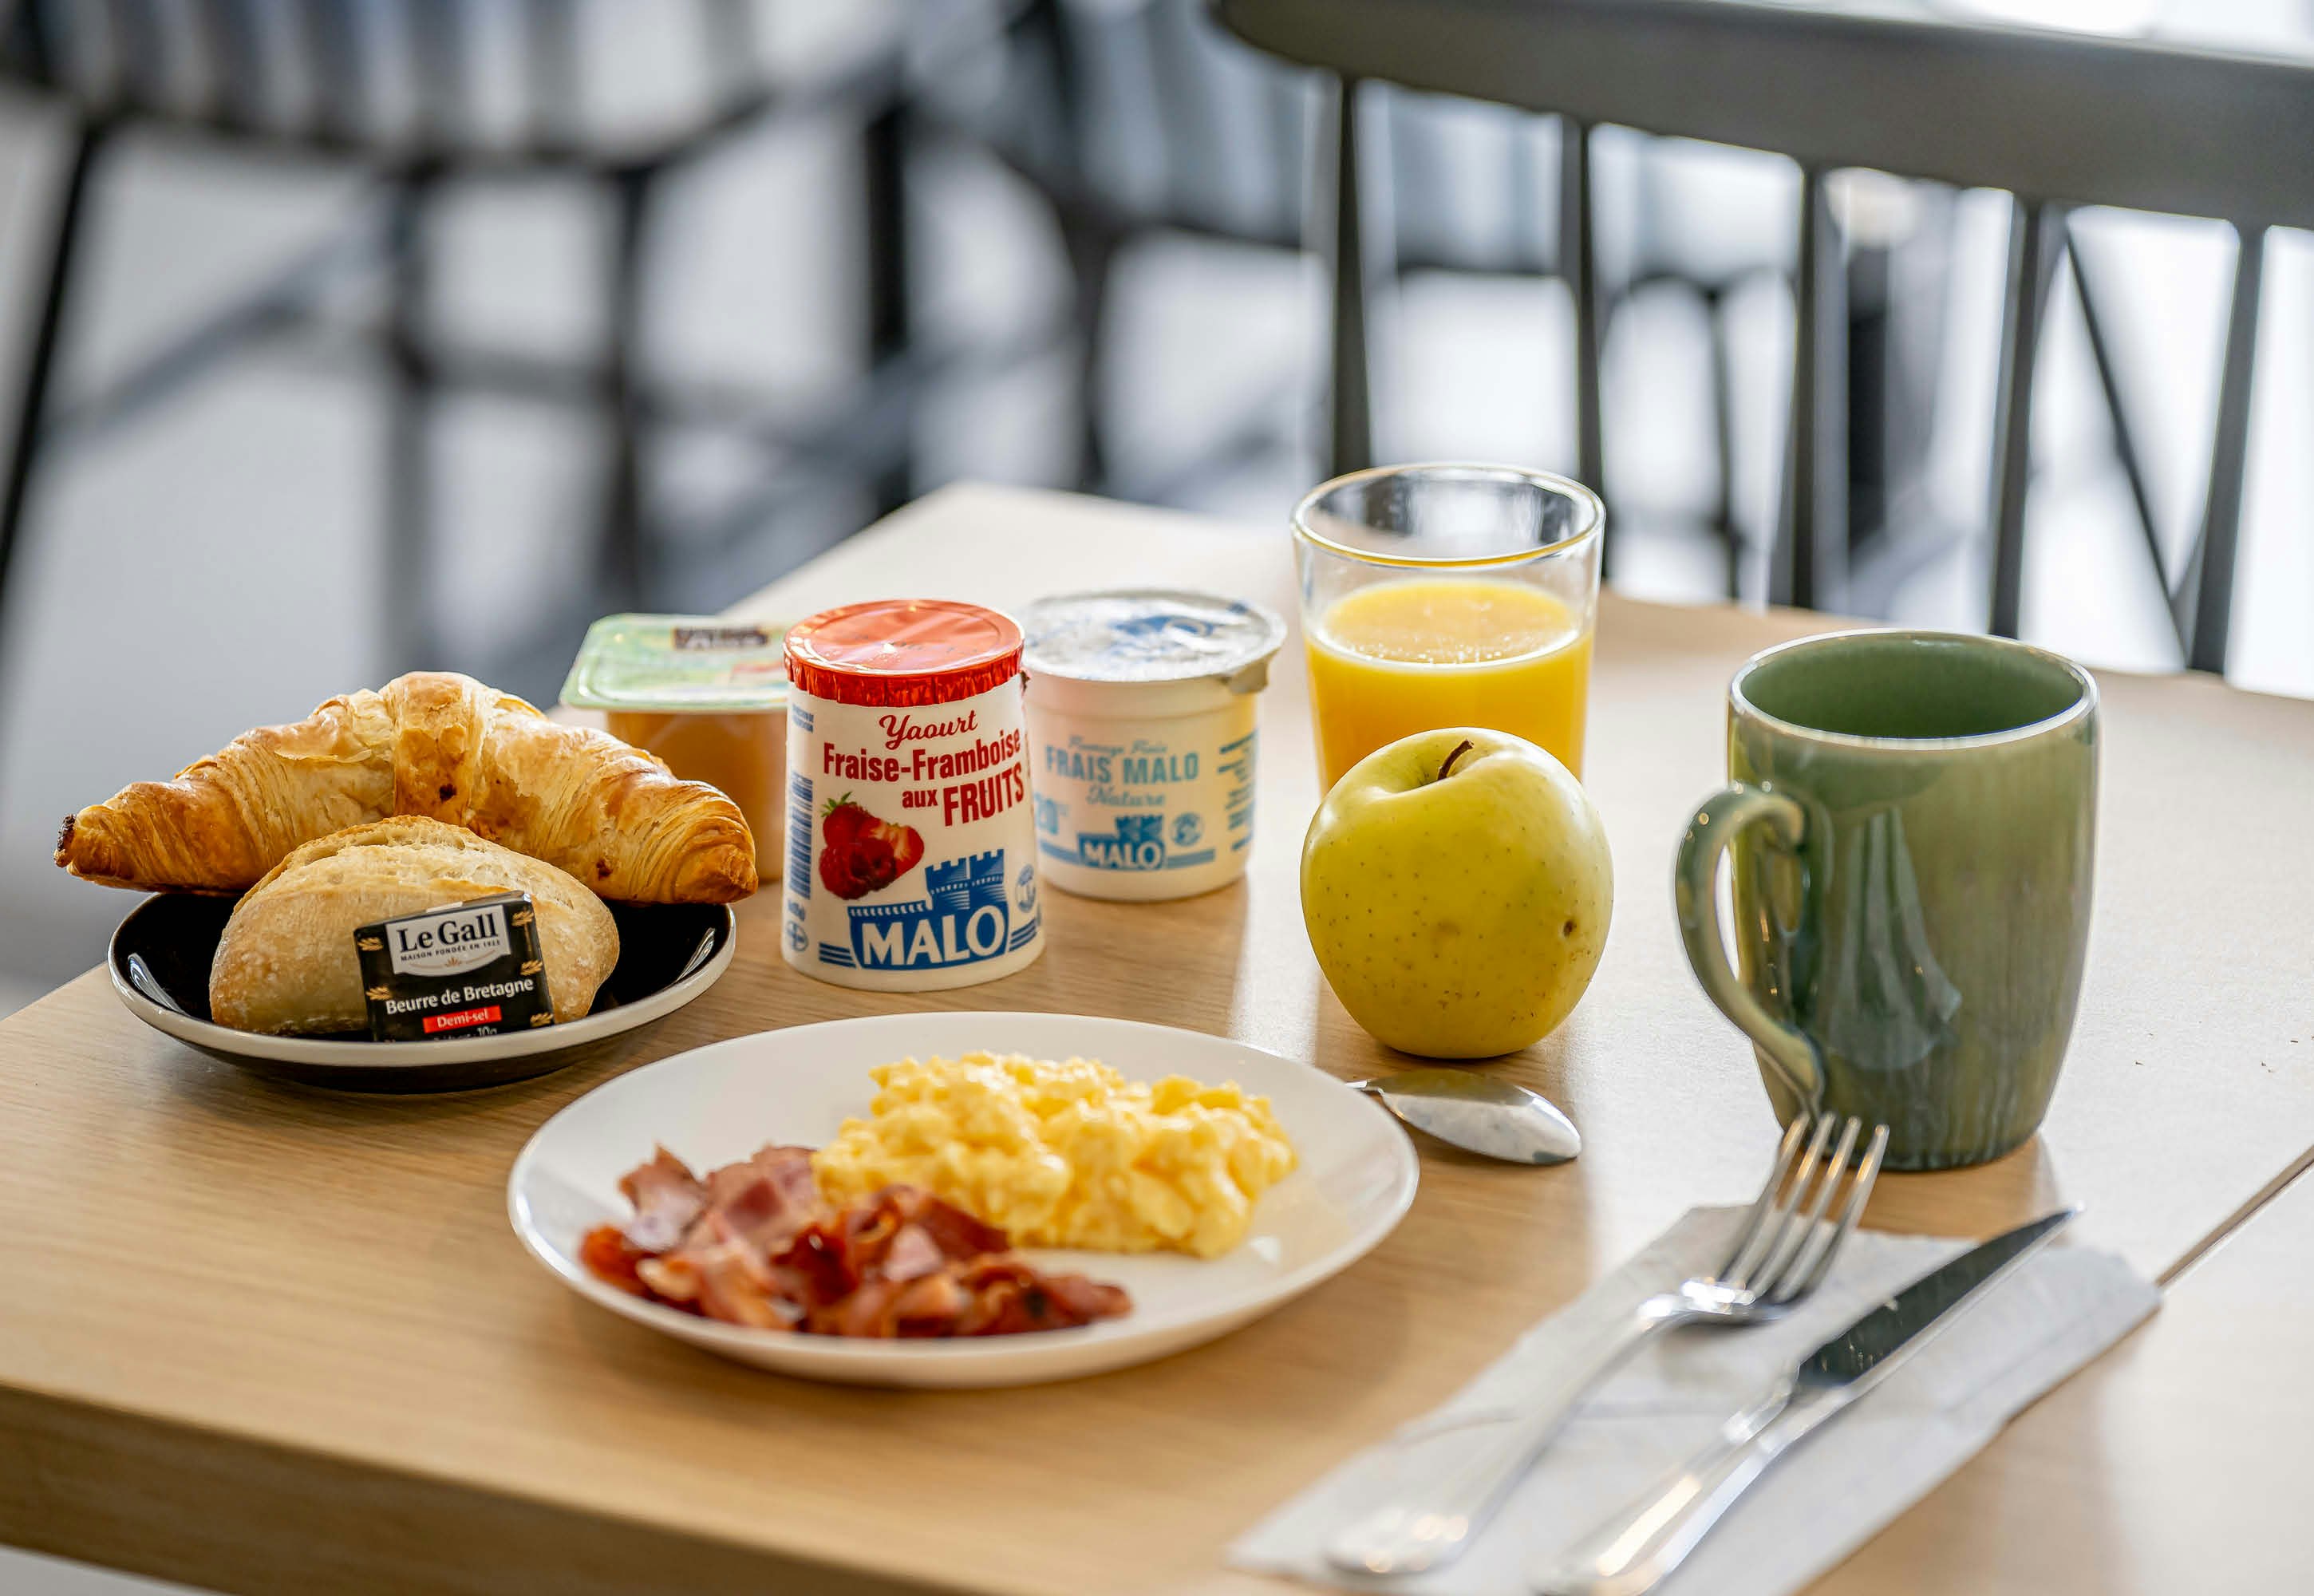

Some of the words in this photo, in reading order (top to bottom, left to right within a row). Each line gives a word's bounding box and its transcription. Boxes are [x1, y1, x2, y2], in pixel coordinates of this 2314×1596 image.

[879, 709, 978, 750] Yaourt
[823, 729, 1021, 782] Fraise-Framboise
[1044, 745, 1112, 784] FRAIS
[1123, 752, 1200, 784] MALO
[902, 789, 938, 808] aux
[943, 762, 1025, 827] FRUITS
[1083, 841, 1161, 869] MALO
[396, 928, 433, 954] Le
[437, 912, 499, 946] Gall
[861, 905, 1005, 966] MALO
[401, 952, 432, 962] MAISON
[385, 994, 439, 1015] Beurre
[440, 989, 460, 1005] de
[464, 978, 535, 1001] Bretagne
[436, 1008, 489, 1029] Demi-sel
